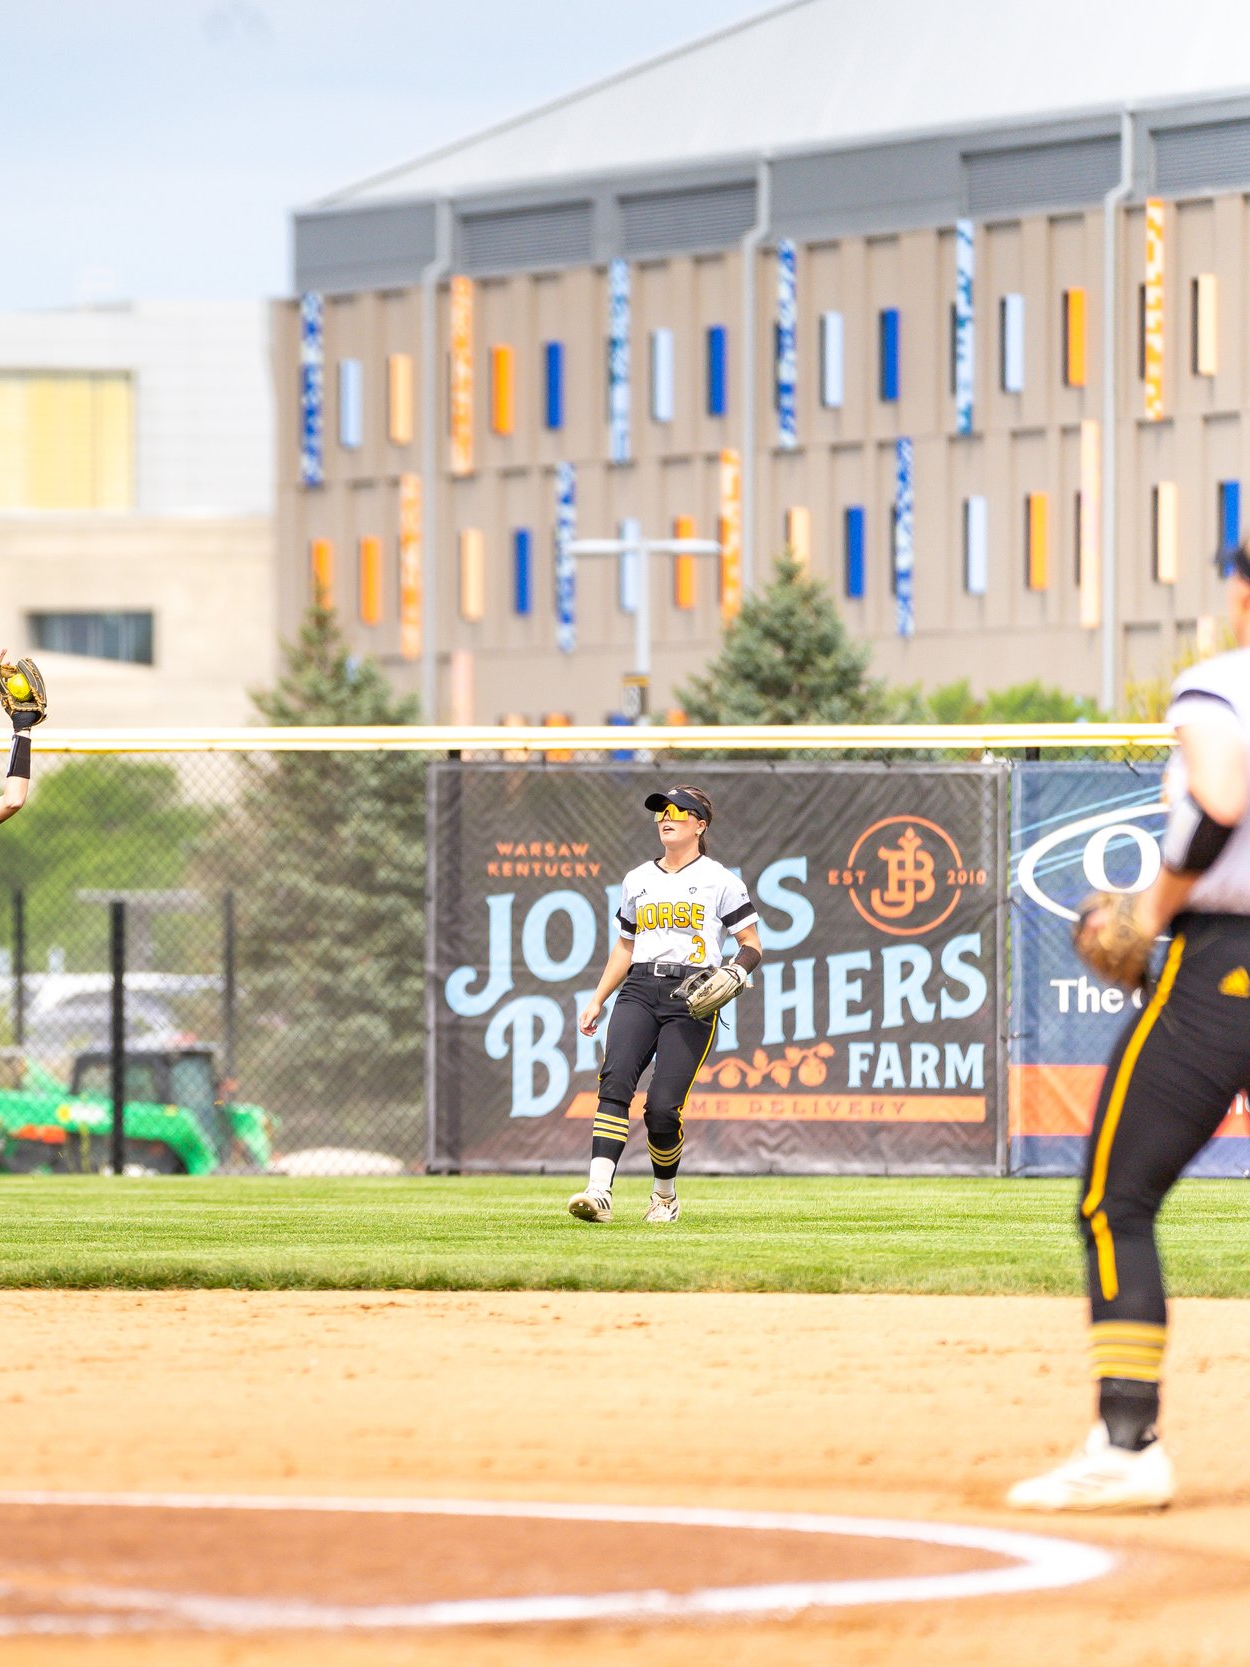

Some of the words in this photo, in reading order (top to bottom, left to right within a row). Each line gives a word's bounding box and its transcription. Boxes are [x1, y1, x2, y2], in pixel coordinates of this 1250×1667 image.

[495, 841, 589, 858] WARSAW
[487, 861, 601, 878] KENTUCKY
[827, 869, 867, 886] EST
[946, 868, 988, 886] 2010
[445, 855, 815, 1017] JOS
[688, 935, 707, 965] 3
[1050, 976, 1124, 1014] The
[847, 1042, 985, 1089] FARM
[749, 1099, 906, 1115] DELIVERY
